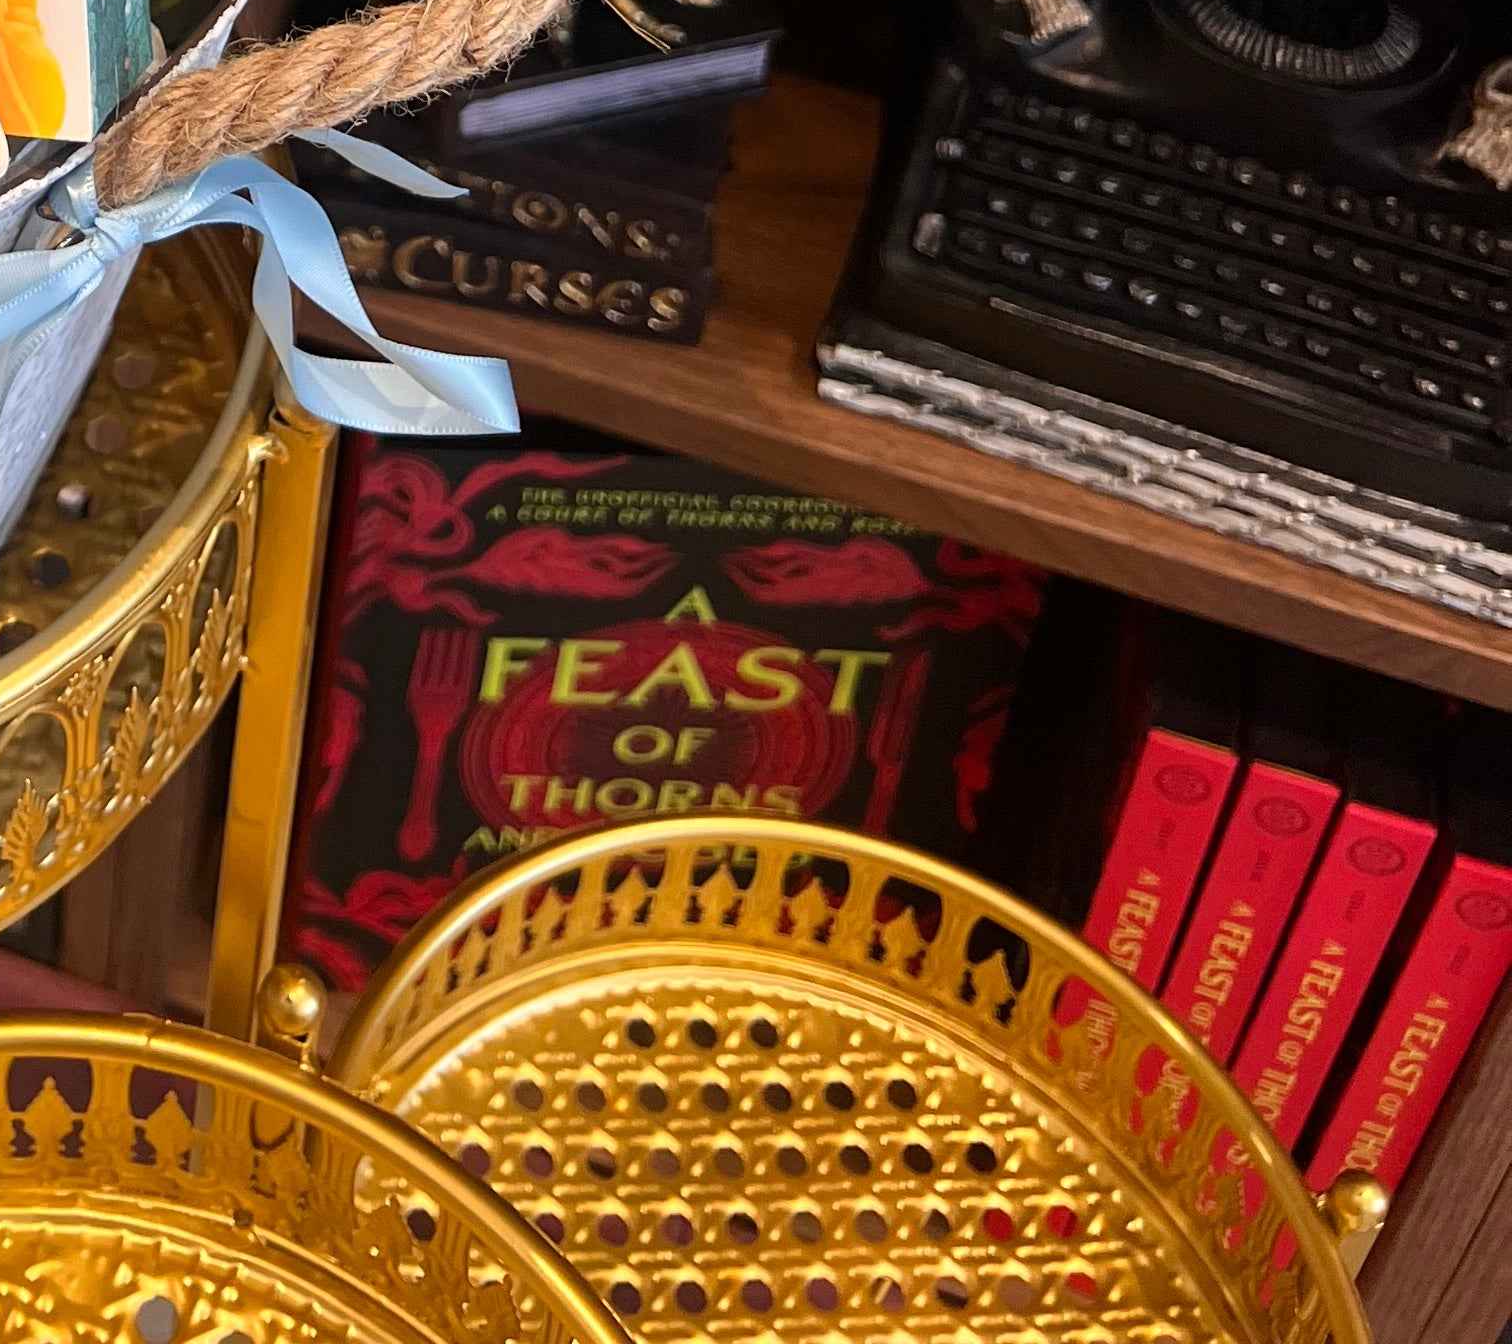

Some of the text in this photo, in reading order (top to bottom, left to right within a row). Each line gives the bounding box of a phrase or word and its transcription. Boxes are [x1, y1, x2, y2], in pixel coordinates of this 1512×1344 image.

[663, 584, 719, 627] A
[476, 635, 894, 717] FEAST
[612, 724, 717, 766] OF
[498, 772, 807, 816] THORNS
[1192, 919, 1255, 1006] FEAST
[1281, 958, 1344, 1045] FEAST
[1382, 1011, 1448, 1097] FEAST
